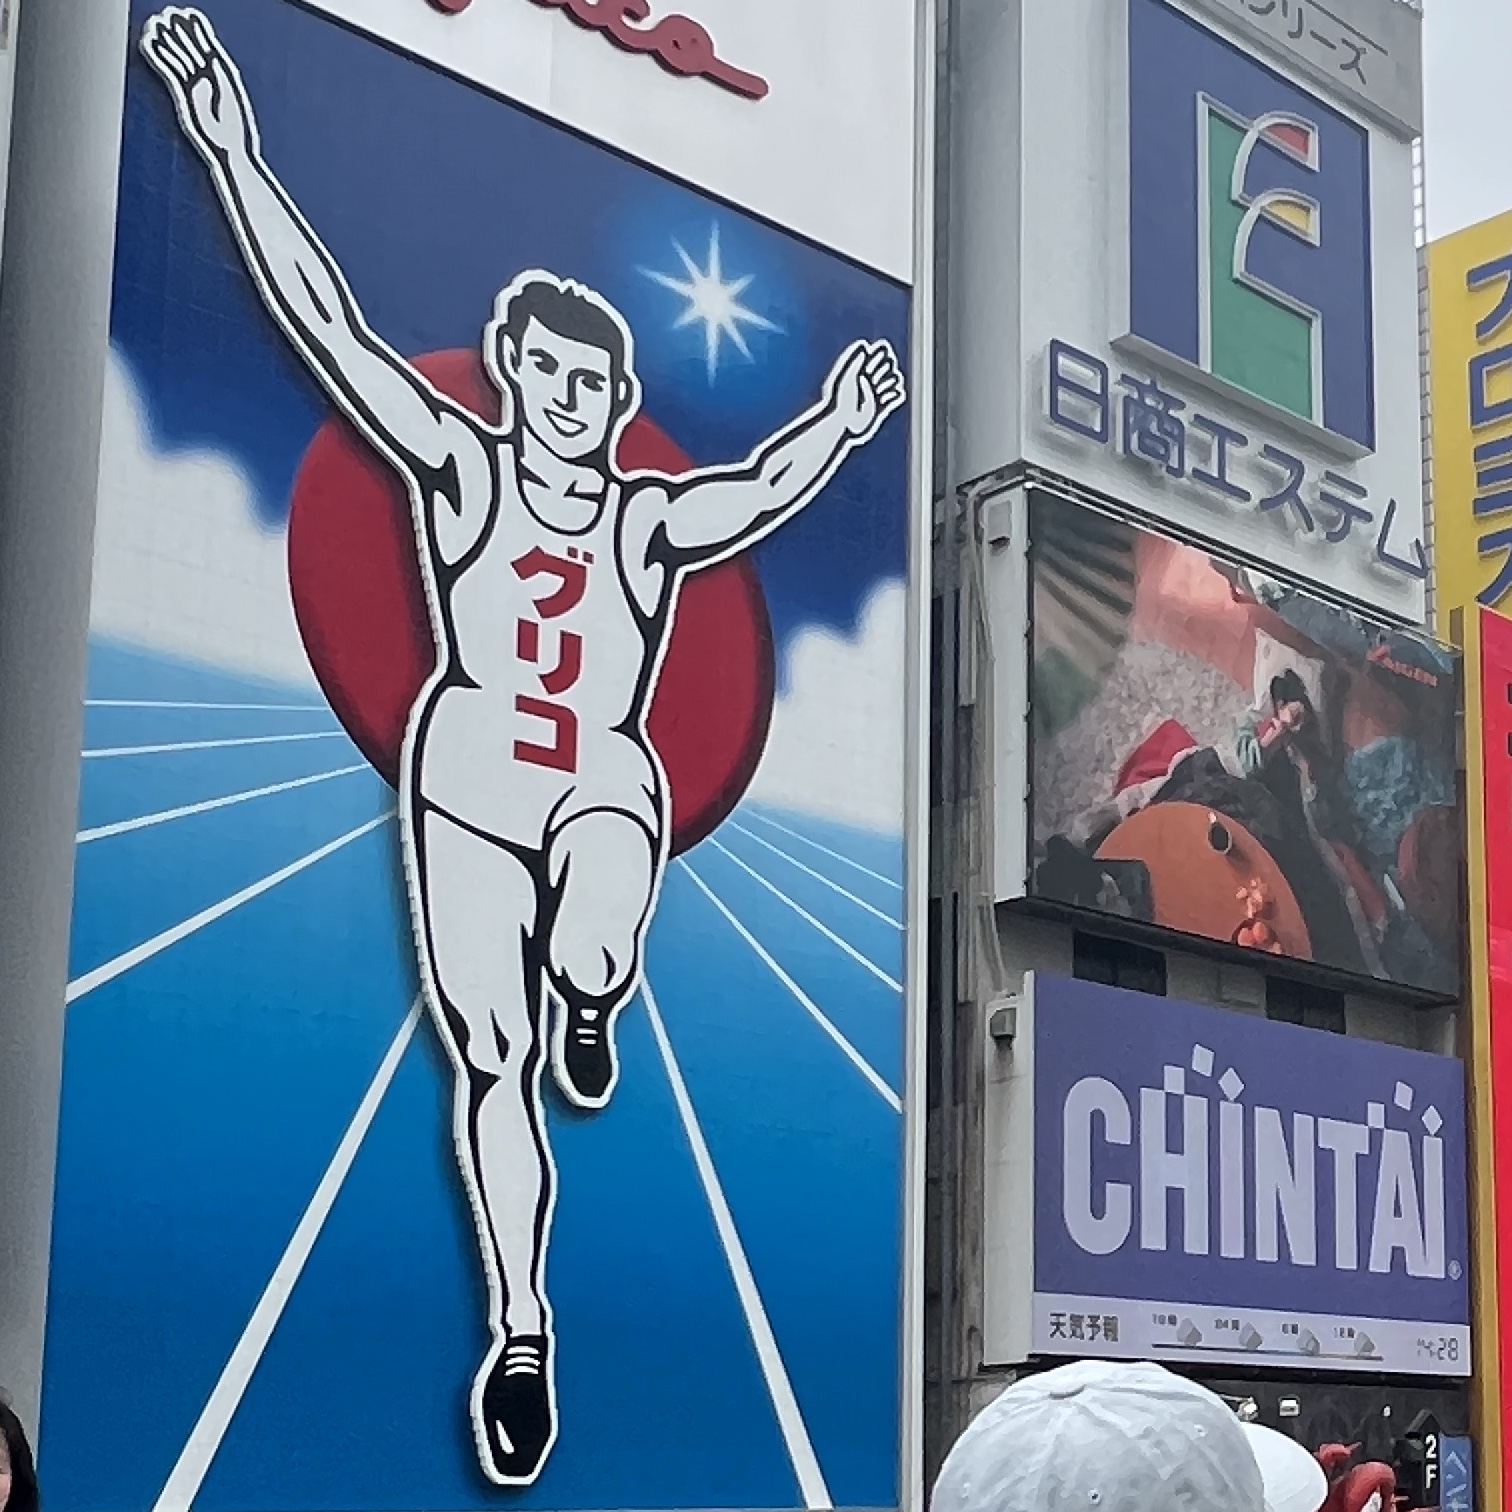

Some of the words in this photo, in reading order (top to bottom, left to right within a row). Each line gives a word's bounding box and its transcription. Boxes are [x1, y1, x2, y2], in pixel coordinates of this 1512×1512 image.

[1050, 337, 1428, 578] 日商エステム
[513, 545, 594, 773] グリコ
[1063, 1042, 1446, 1280] CHINTAI
[1424, 1433, 1438, 1489] 2F
